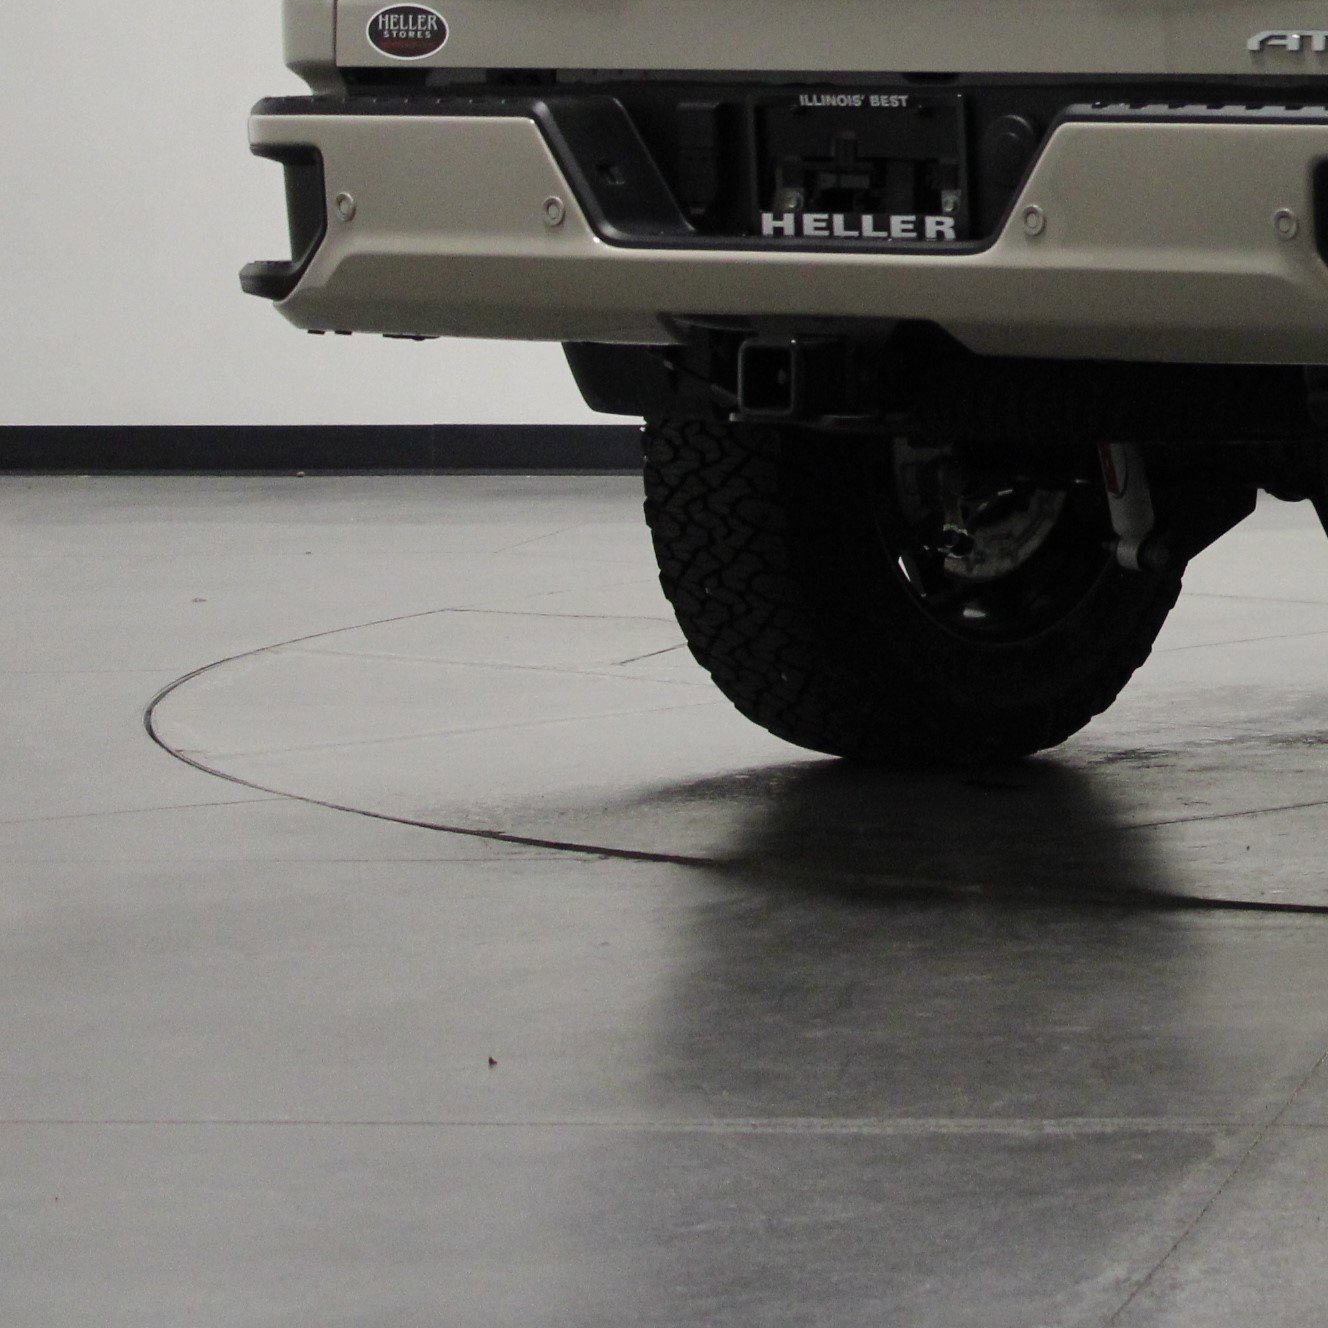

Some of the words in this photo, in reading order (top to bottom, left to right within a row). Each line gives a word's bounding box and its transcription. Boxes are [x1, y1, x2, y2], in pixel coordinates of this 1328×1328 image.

[378, 14, 438, 30] HELLER
[383, 30, 432, 39] STORES
[869, 94, 909, 107] BEST
[761, 212, 957, 240] HELLER
